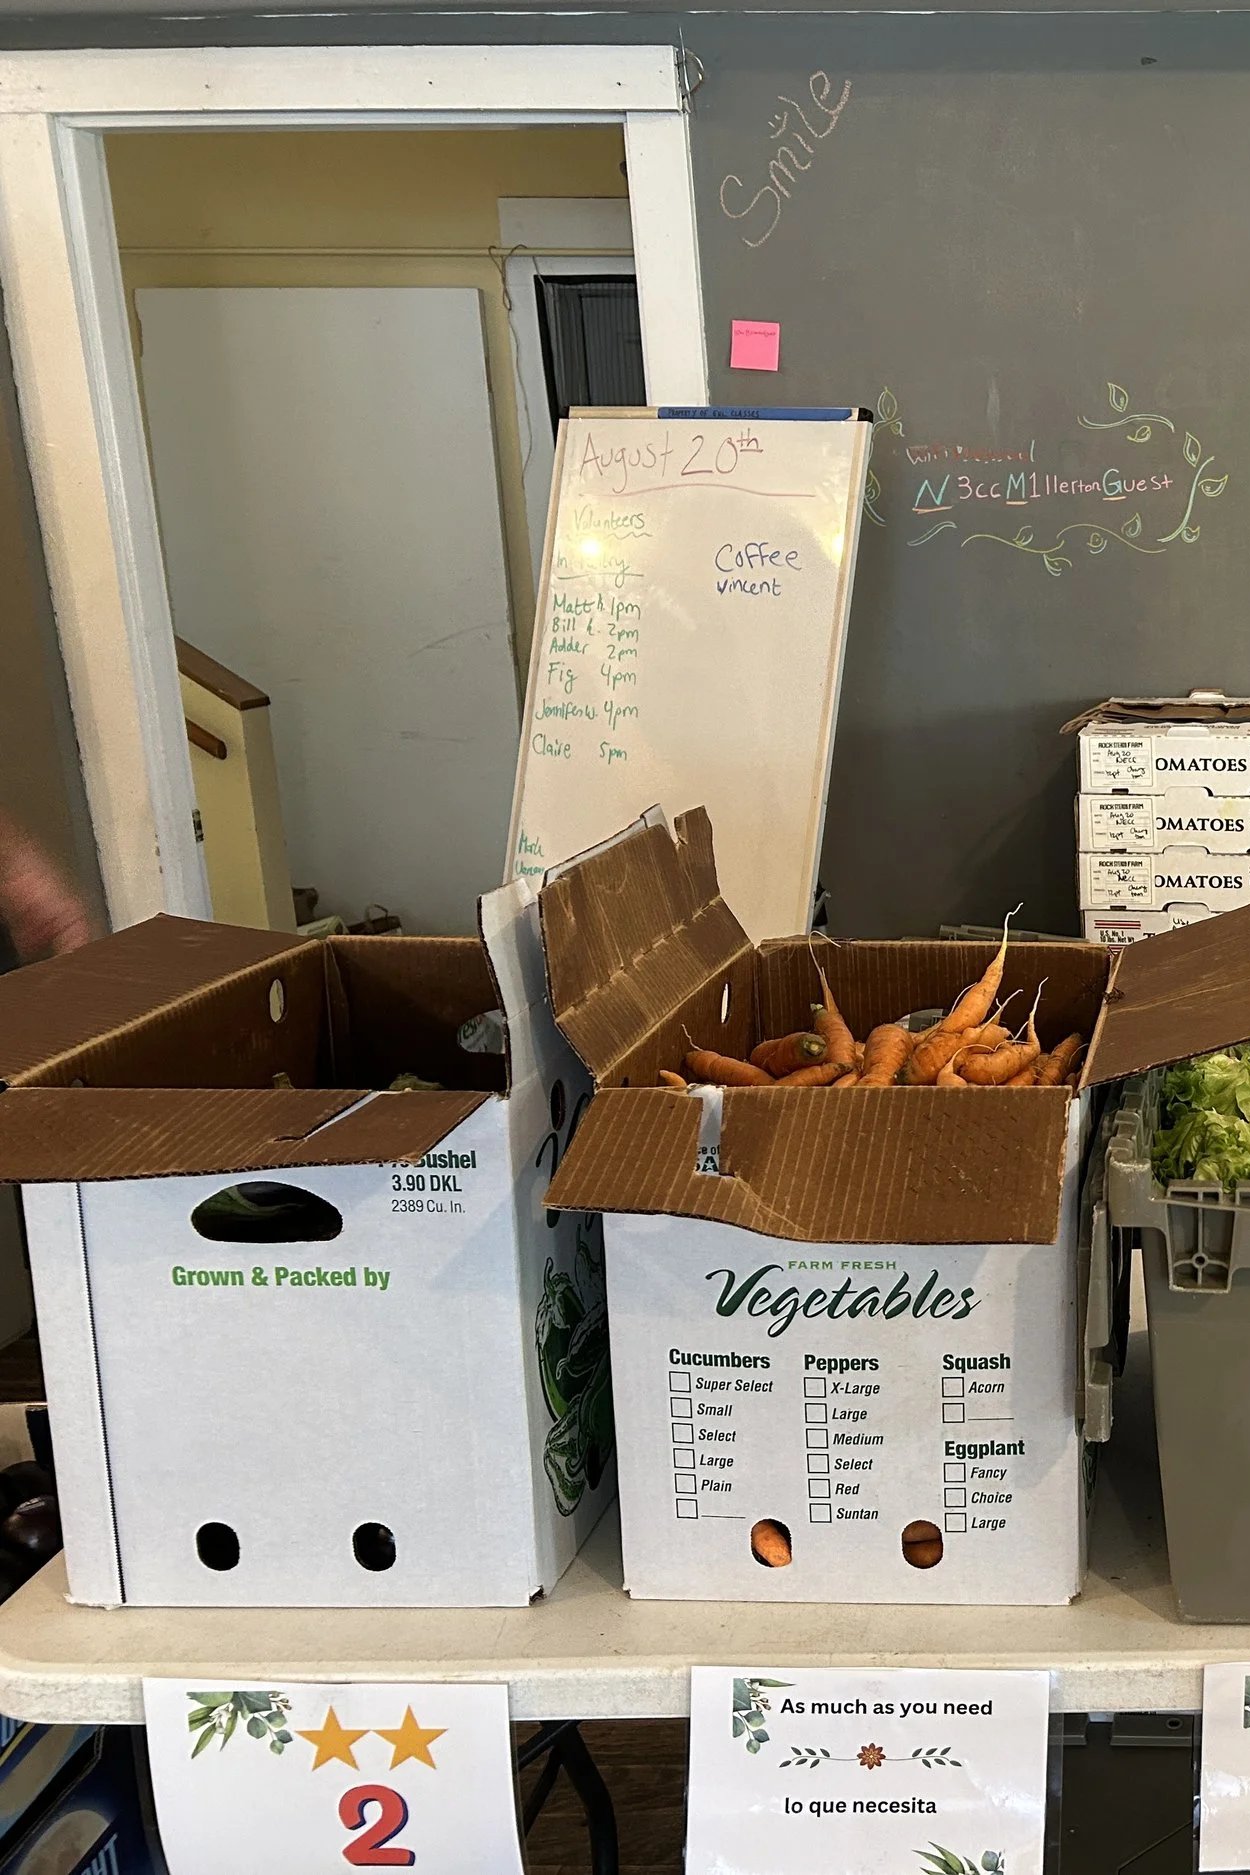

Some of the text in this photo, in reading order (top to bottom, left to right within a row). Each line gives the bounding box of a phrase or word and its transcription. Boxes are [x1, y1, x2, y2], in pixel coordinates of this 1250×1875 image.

[579, 430, 675, 493] August
[574, 504, 645, 530] Volunteers
[714, 541, 802, 572] Coffee
[553, 593, 595, 616] Matt
[552, 616, 640, 642] Bill 2pm
[549, 636, 638, 661] Adder 2pm
[547, 662, 637, 693] Fig 4pm
[603, 701, 639, 730] 4pm
[532, 733, 628, 764] Claire 5pm
[1155, 757, 1247, 772] OMATOES
[1156, 817, 1244, 832] OMATOES
[1154, 875, 1243, 889] OMATOES
[392, 1174, 463, 1192] 3.90 DKL
[391, 1199, 466, 1214] 2389 Cu. In.
[788, 1261, 897, 1270] FARM FRESH
[171, 1265, 391, 1292] Grown & Packed by
[705, 1264, 982, 1338] Vegetables
[669, 1348, 771, 1370] Cucumbers
[803, 1354, 880, 1374] Peppers
[942, 1353, 1012, 1373] Squash
[695, 1378, 774, 1394] Super Select
[830, 1381, 881, 1397] X-Large
[968, 1380, 1005, 1394] Acorn
[696, 1403, 733, 1417] Small
[832, 1407, 868, 1423] Large
[698, 1428, 736, 1443] Select
[832, 1432, 884, 1446] Medium
[944, 1439, 1026, 1460] Eggplant
[699, 1454, 734, 1470] Large
[834, 1457, 873, 1471] Select
[970, 1466, 1007, 1482] Fancy
[700, 1479, 733, 1493] Plain
[835, 1482, 860, 1496] Red
[971, 1490, 1013, 1505] Choice
[836, 1506, 879, 1521] Suntan
[971, 1515, 1007, 1531] Large
[780, 1699, 993, 1718] As much as you need
[784, 1797, 937, 1818] lo que necesita
[337, 1784, 416, 1866] 2
